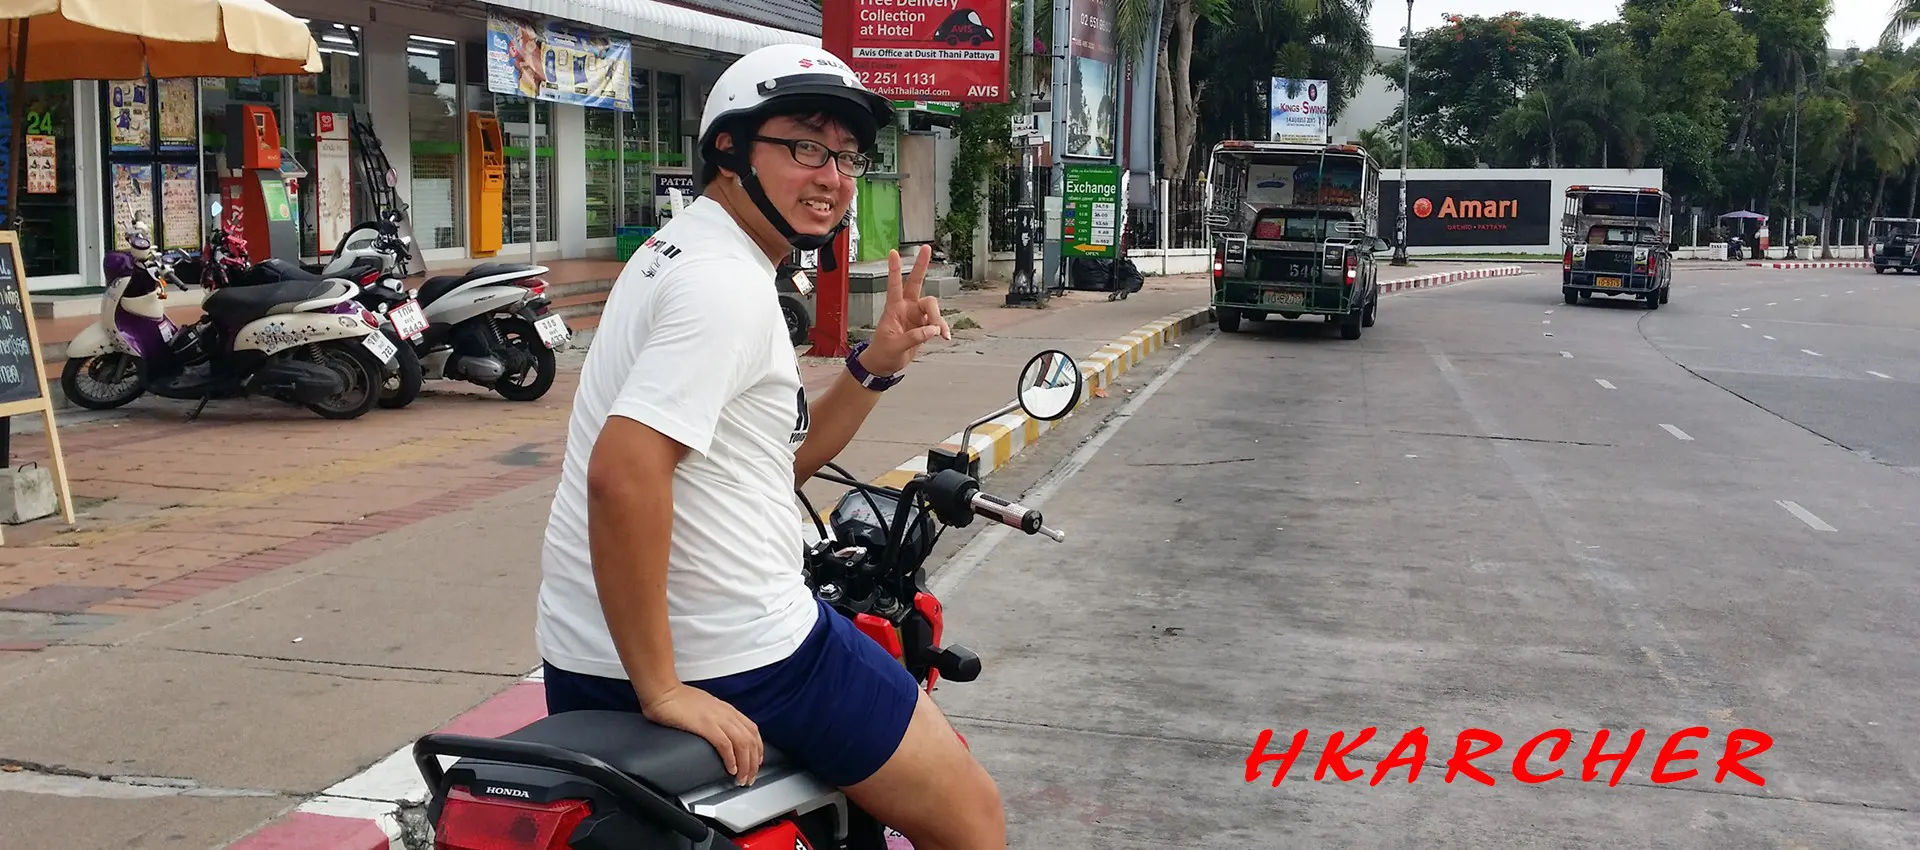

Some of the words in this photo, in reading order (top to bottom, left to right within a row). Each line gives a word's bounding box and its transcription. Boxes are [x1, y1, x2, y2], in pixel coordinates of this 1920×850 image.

[897, 0, 958, 10] Delivery
[860, 9, 925, 22] Collection
[860, 26, 873, 36] at
[877, 24, 913, 36] Hotel
[951, 25, 973, 33] AVIS
[859, 49, 876, 57] Avis
[878, 49, 903, 57] Office
[915, 50, 936, 58] Dusit
[939, 50, 961, 58] Thani
[964, 51, 995, 60] Pattaya
[855, 72, 870, 84] 02
[874, 72, 898, 84] 251
[903, 73, 936, 85] 1131
[967, 85, 999, 97] AVIS
[27, 111, 53, 135] 24
[660, 178, 694, 186] PATTA
[1066, 181, 1116, 197] Exchange
[1437, 196, 1519, 218] Amari
[1477, 223, 1507, 231] PATTAYA
[1290, 264, 1320, 277] 546
[402, 320, 424, 336] 5443
[486, 786, 530, 798] HONDA
